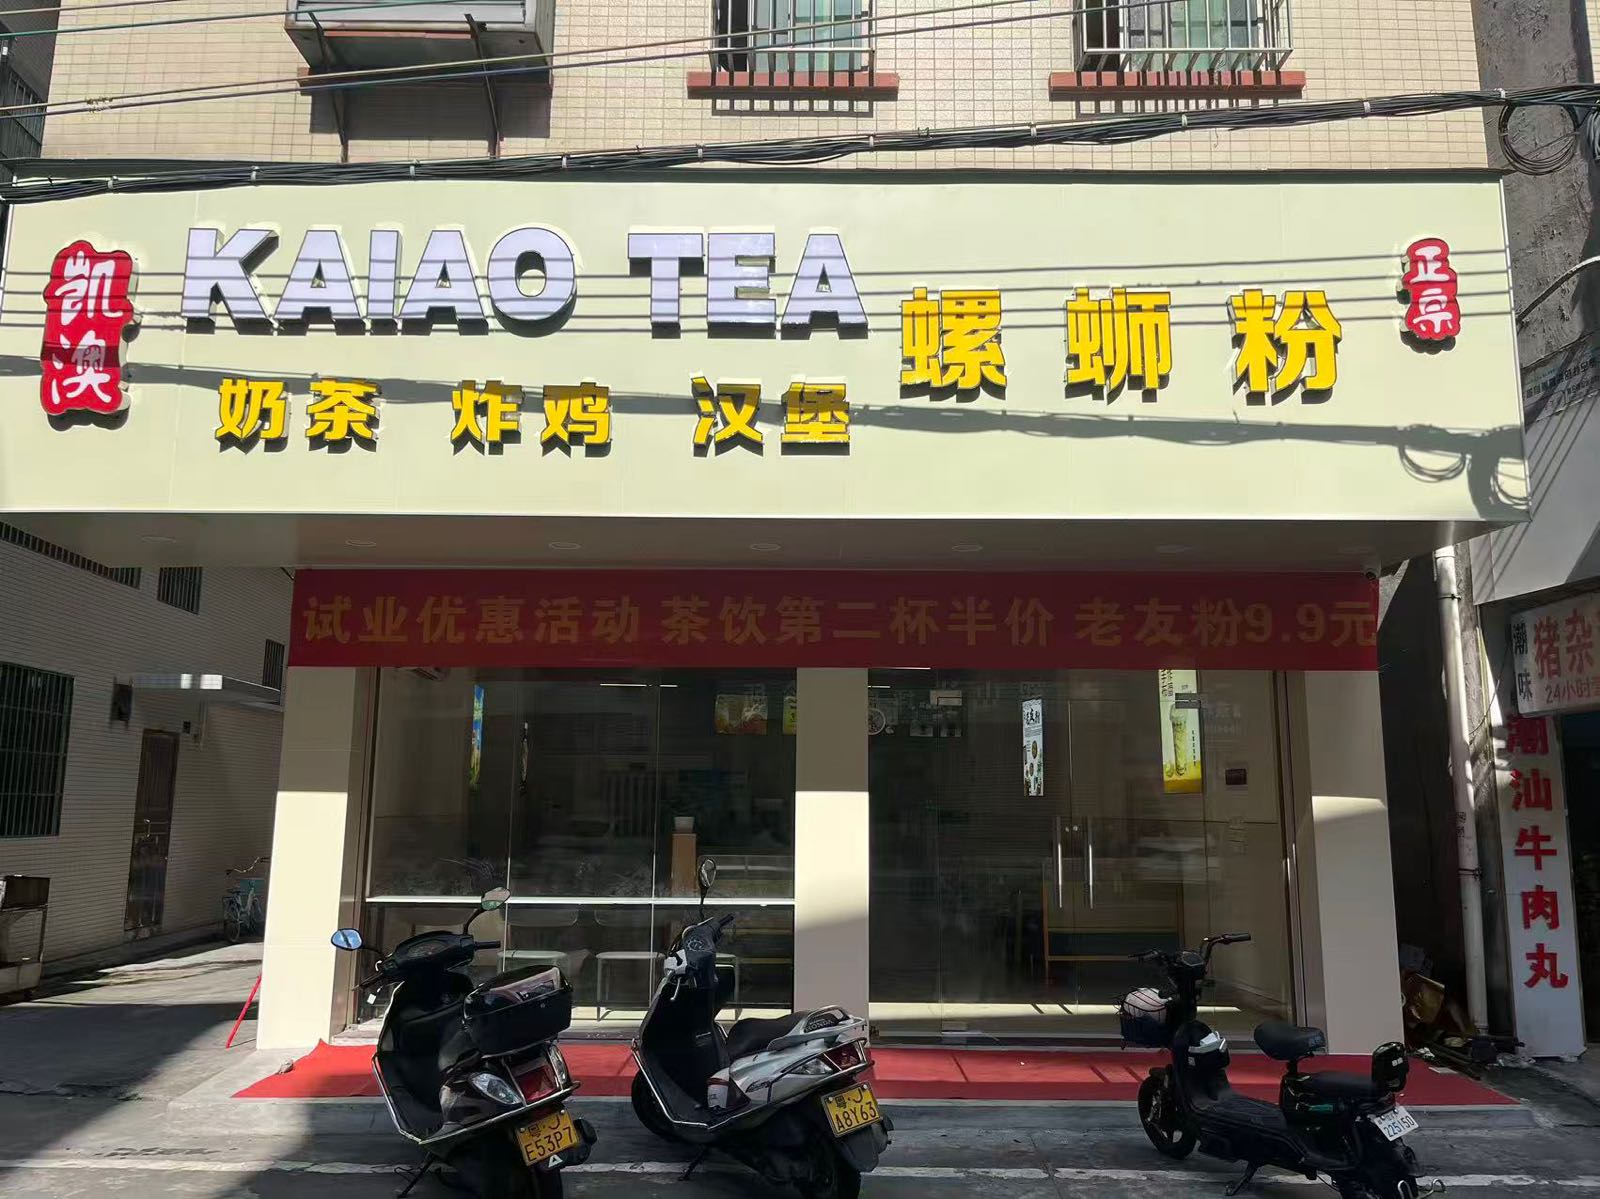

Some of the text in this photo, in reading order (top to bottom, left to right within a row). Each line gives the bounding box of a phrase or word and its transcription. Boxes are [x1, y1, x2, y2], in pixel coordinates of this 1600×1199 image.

[182, 226, 866, 337] KAIAO TEA
[1406, 240, 1460, 339] 正宗
[51, 254, 122, 406] 凯澳
[900, 287, 1341, 393] 螺蛳粉
[216, 376, 849, 448] 奶茶 炸鸡 汉堡
[303, 596, 1378, 648] 试业优惠活动 茶饮第二杯半价 老友粉9.9元
[1534, 606, 1600, 680] 猪杂
[1506, 713, 1568, 989] 潮汕牛肉丸
[524, 1126, 573, 1161] E53P7
[835, 1101, 877, 1131] A8Y63
